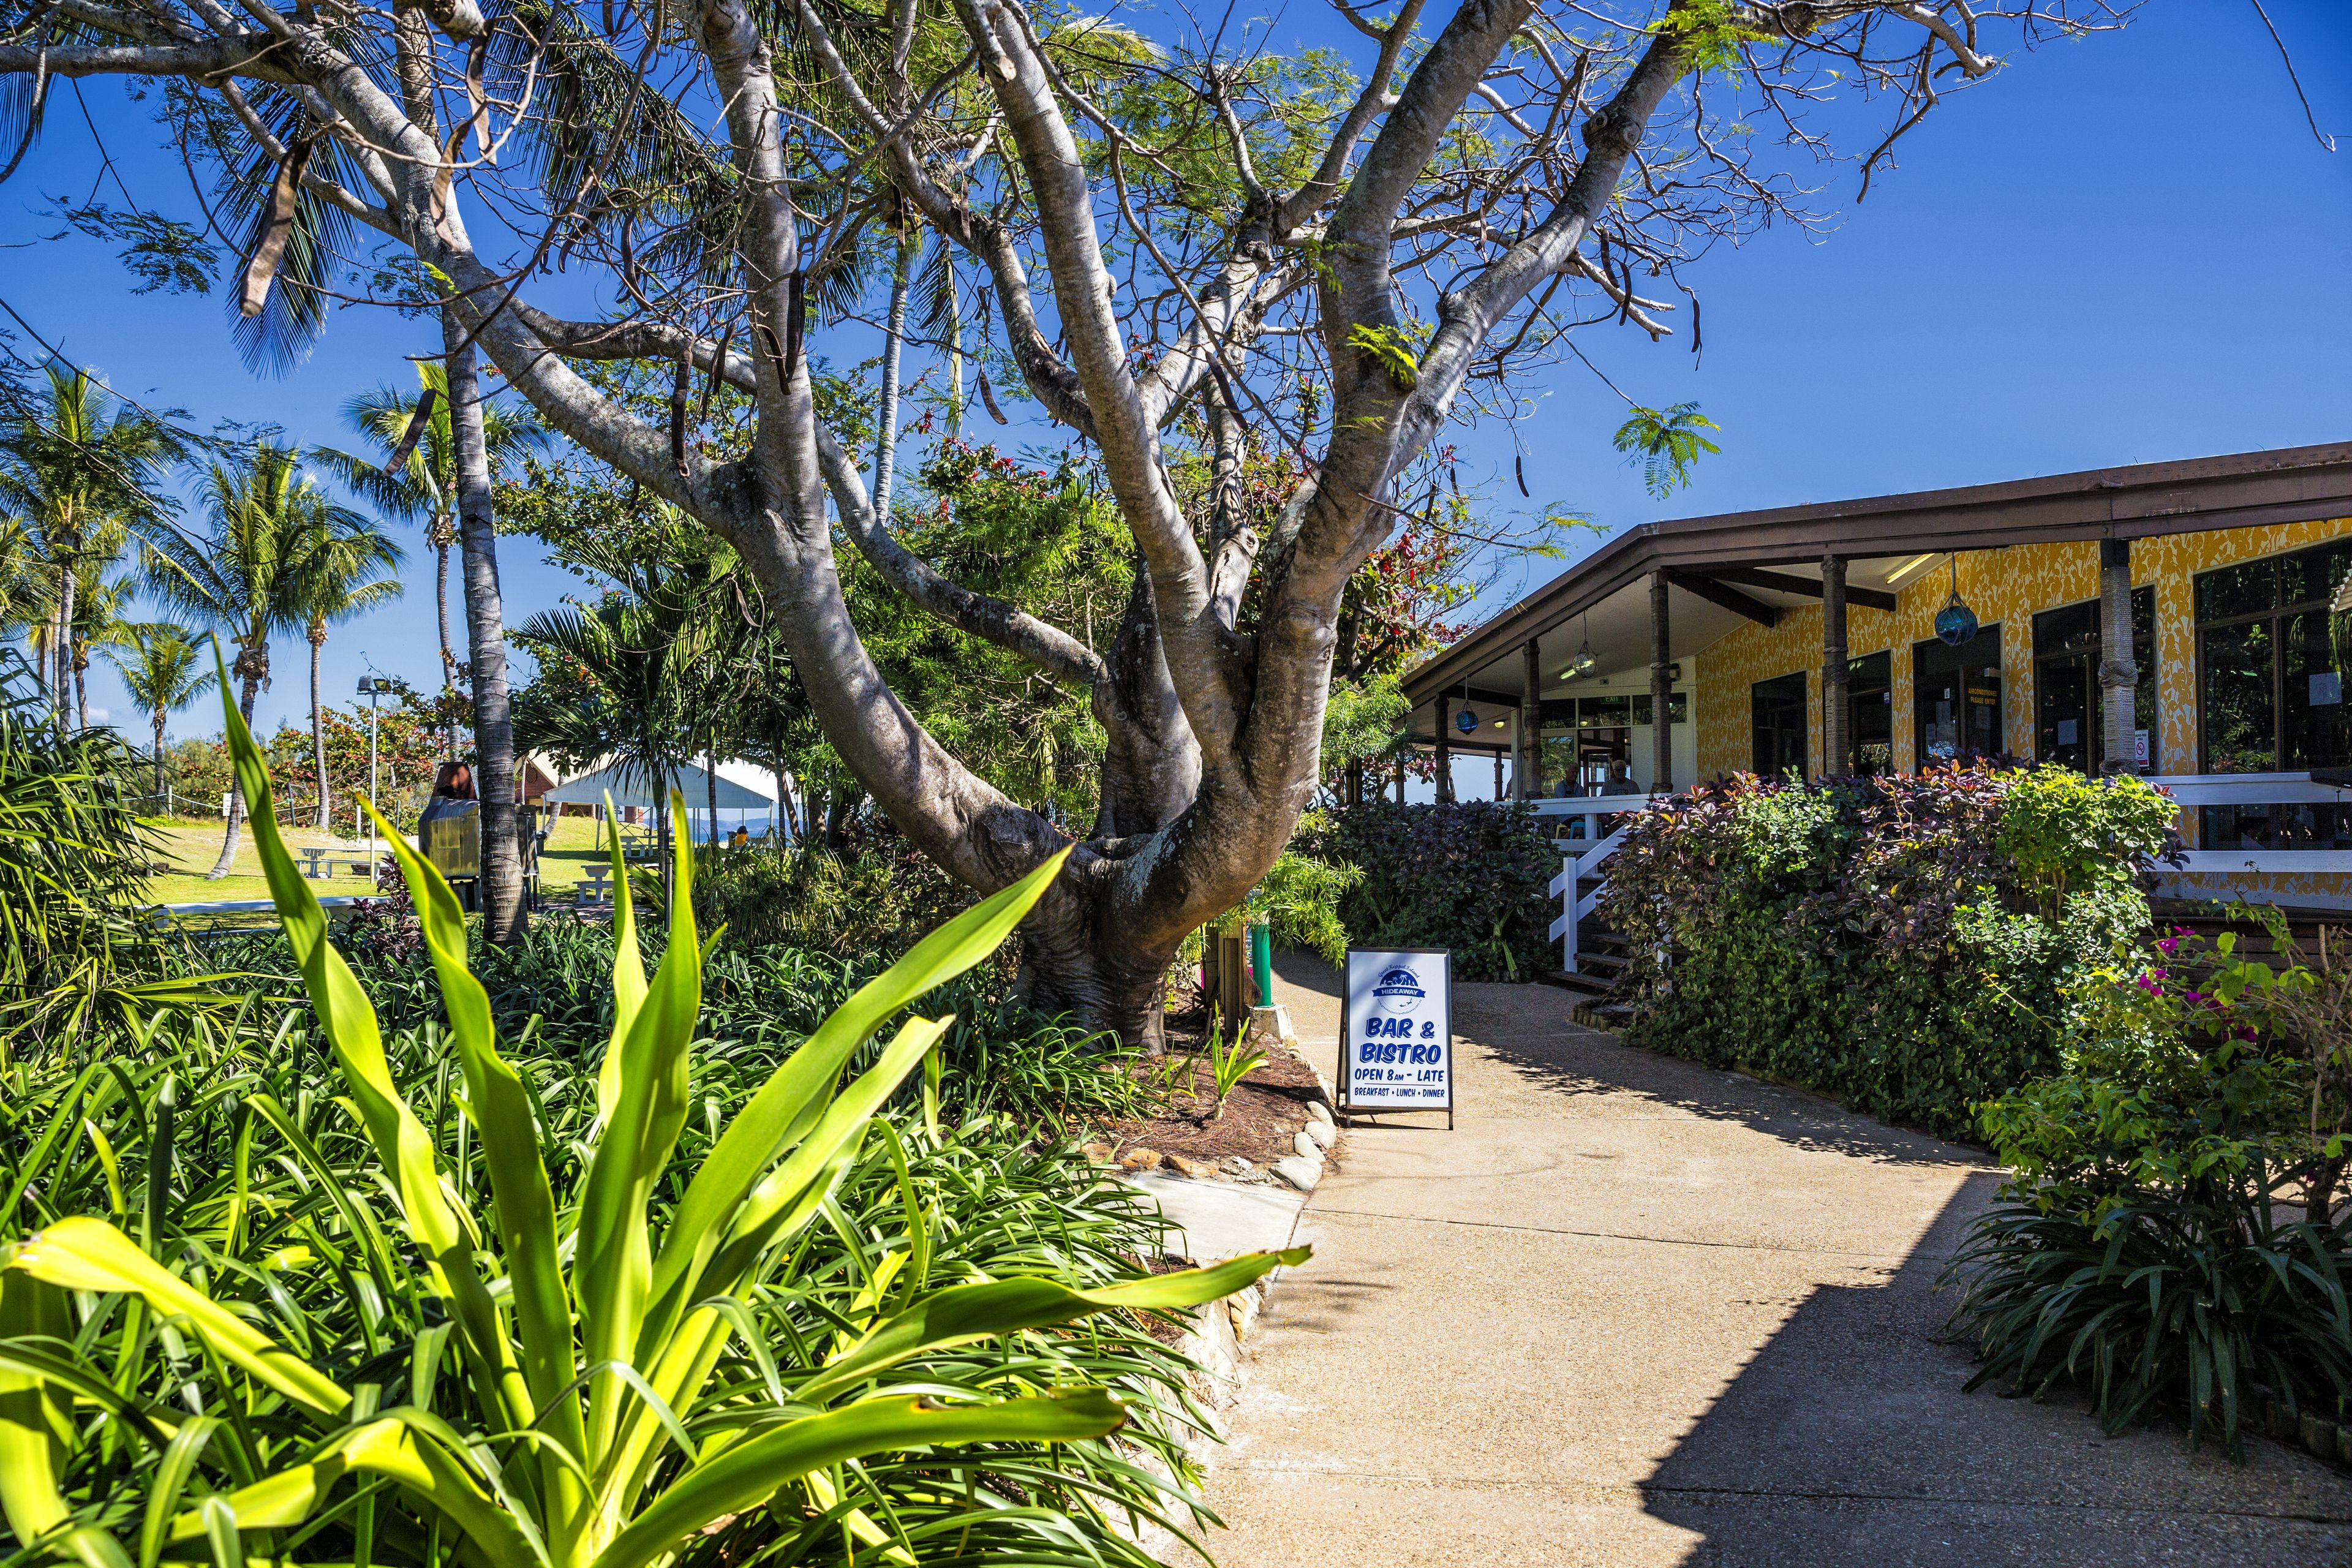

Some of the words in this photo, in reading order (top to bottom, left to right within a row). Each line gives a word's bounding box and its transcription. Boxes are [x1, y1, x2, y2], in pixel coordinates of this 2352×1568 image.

[1378, 968, 1389, 978] Great
[1406, 966, 1420, 978] Island
[1365, 1017, 1414, 1038] BAR
[1420, 1021, 1435, 1039] &
[1359, 1042, 1441, 1065] BISTRO
[1354, 1068, 1384, 1080] OPEN
[1417, 1069, 1444, 1082] LATE
[1354, 1087, 1389, 1096] BREAKFAST
[1396, 1088, 1415, 1097] LUNCH
[1422, 1089, 1445, 1098] DINNER
